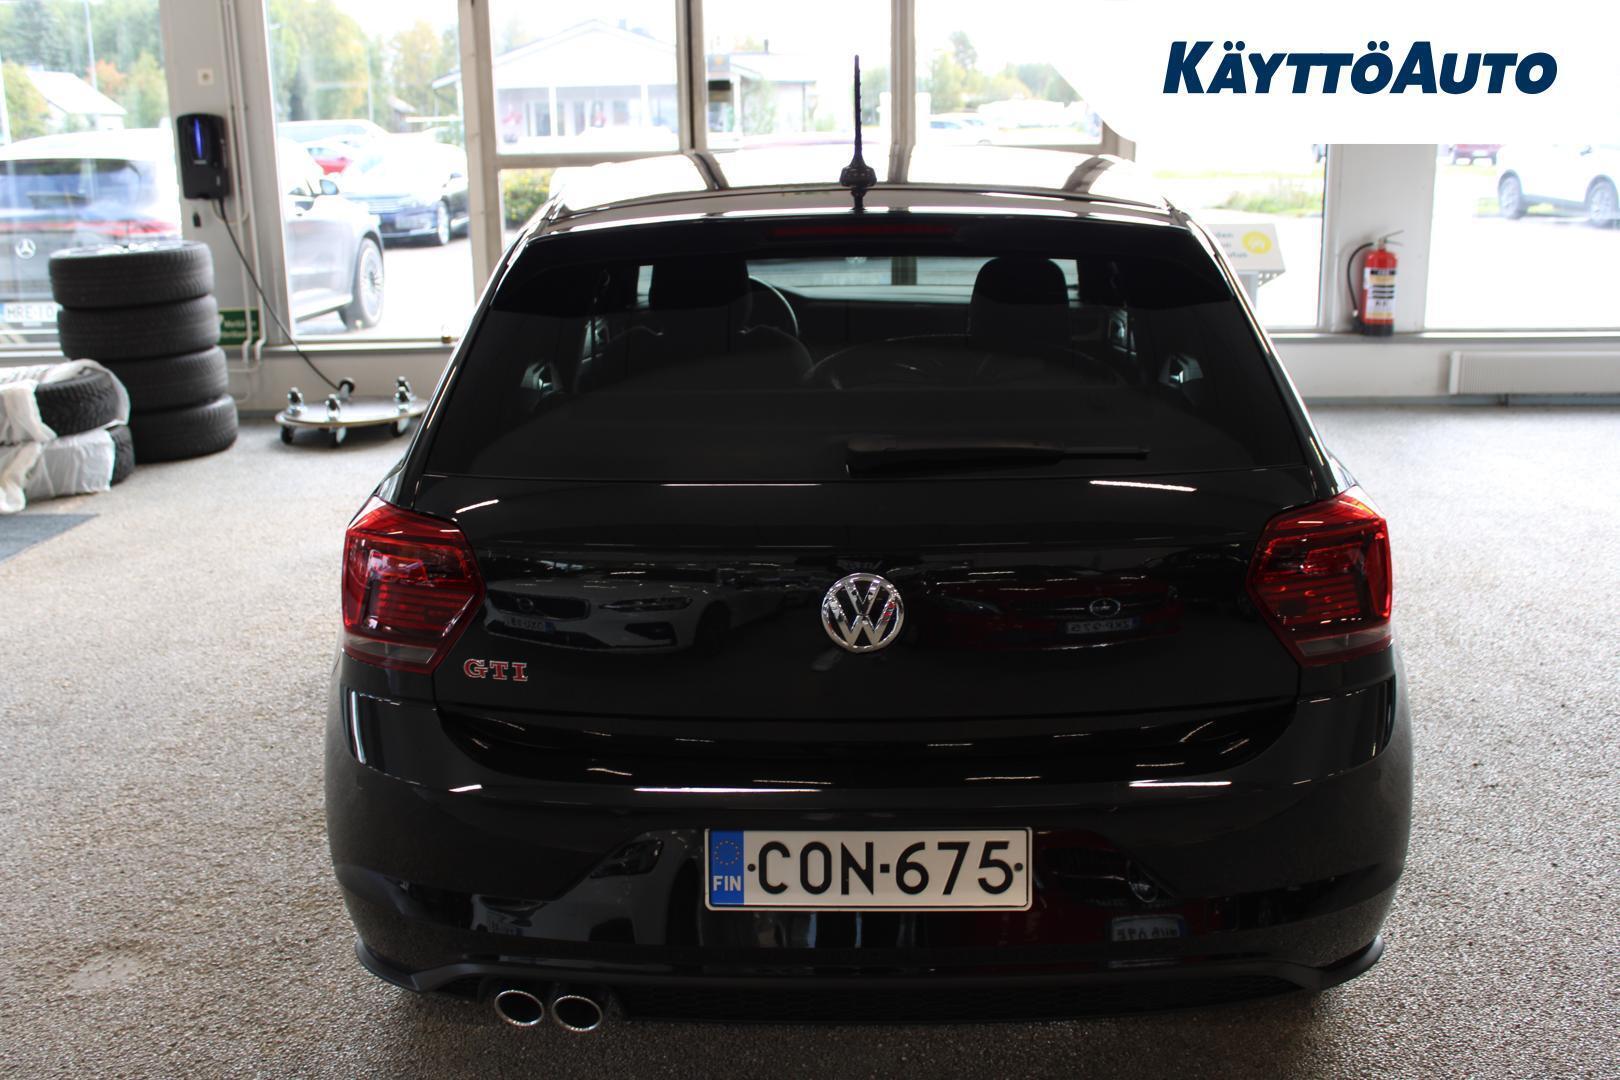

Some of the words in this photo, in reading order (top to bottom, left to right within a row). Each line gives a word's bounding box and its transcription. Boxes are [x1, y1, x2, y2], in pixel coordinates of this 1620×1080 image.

[463, 658, 529, 681] GTI
[758, 840, 1014, 896] CON-675
[712, 875, 742, 892] FIN
